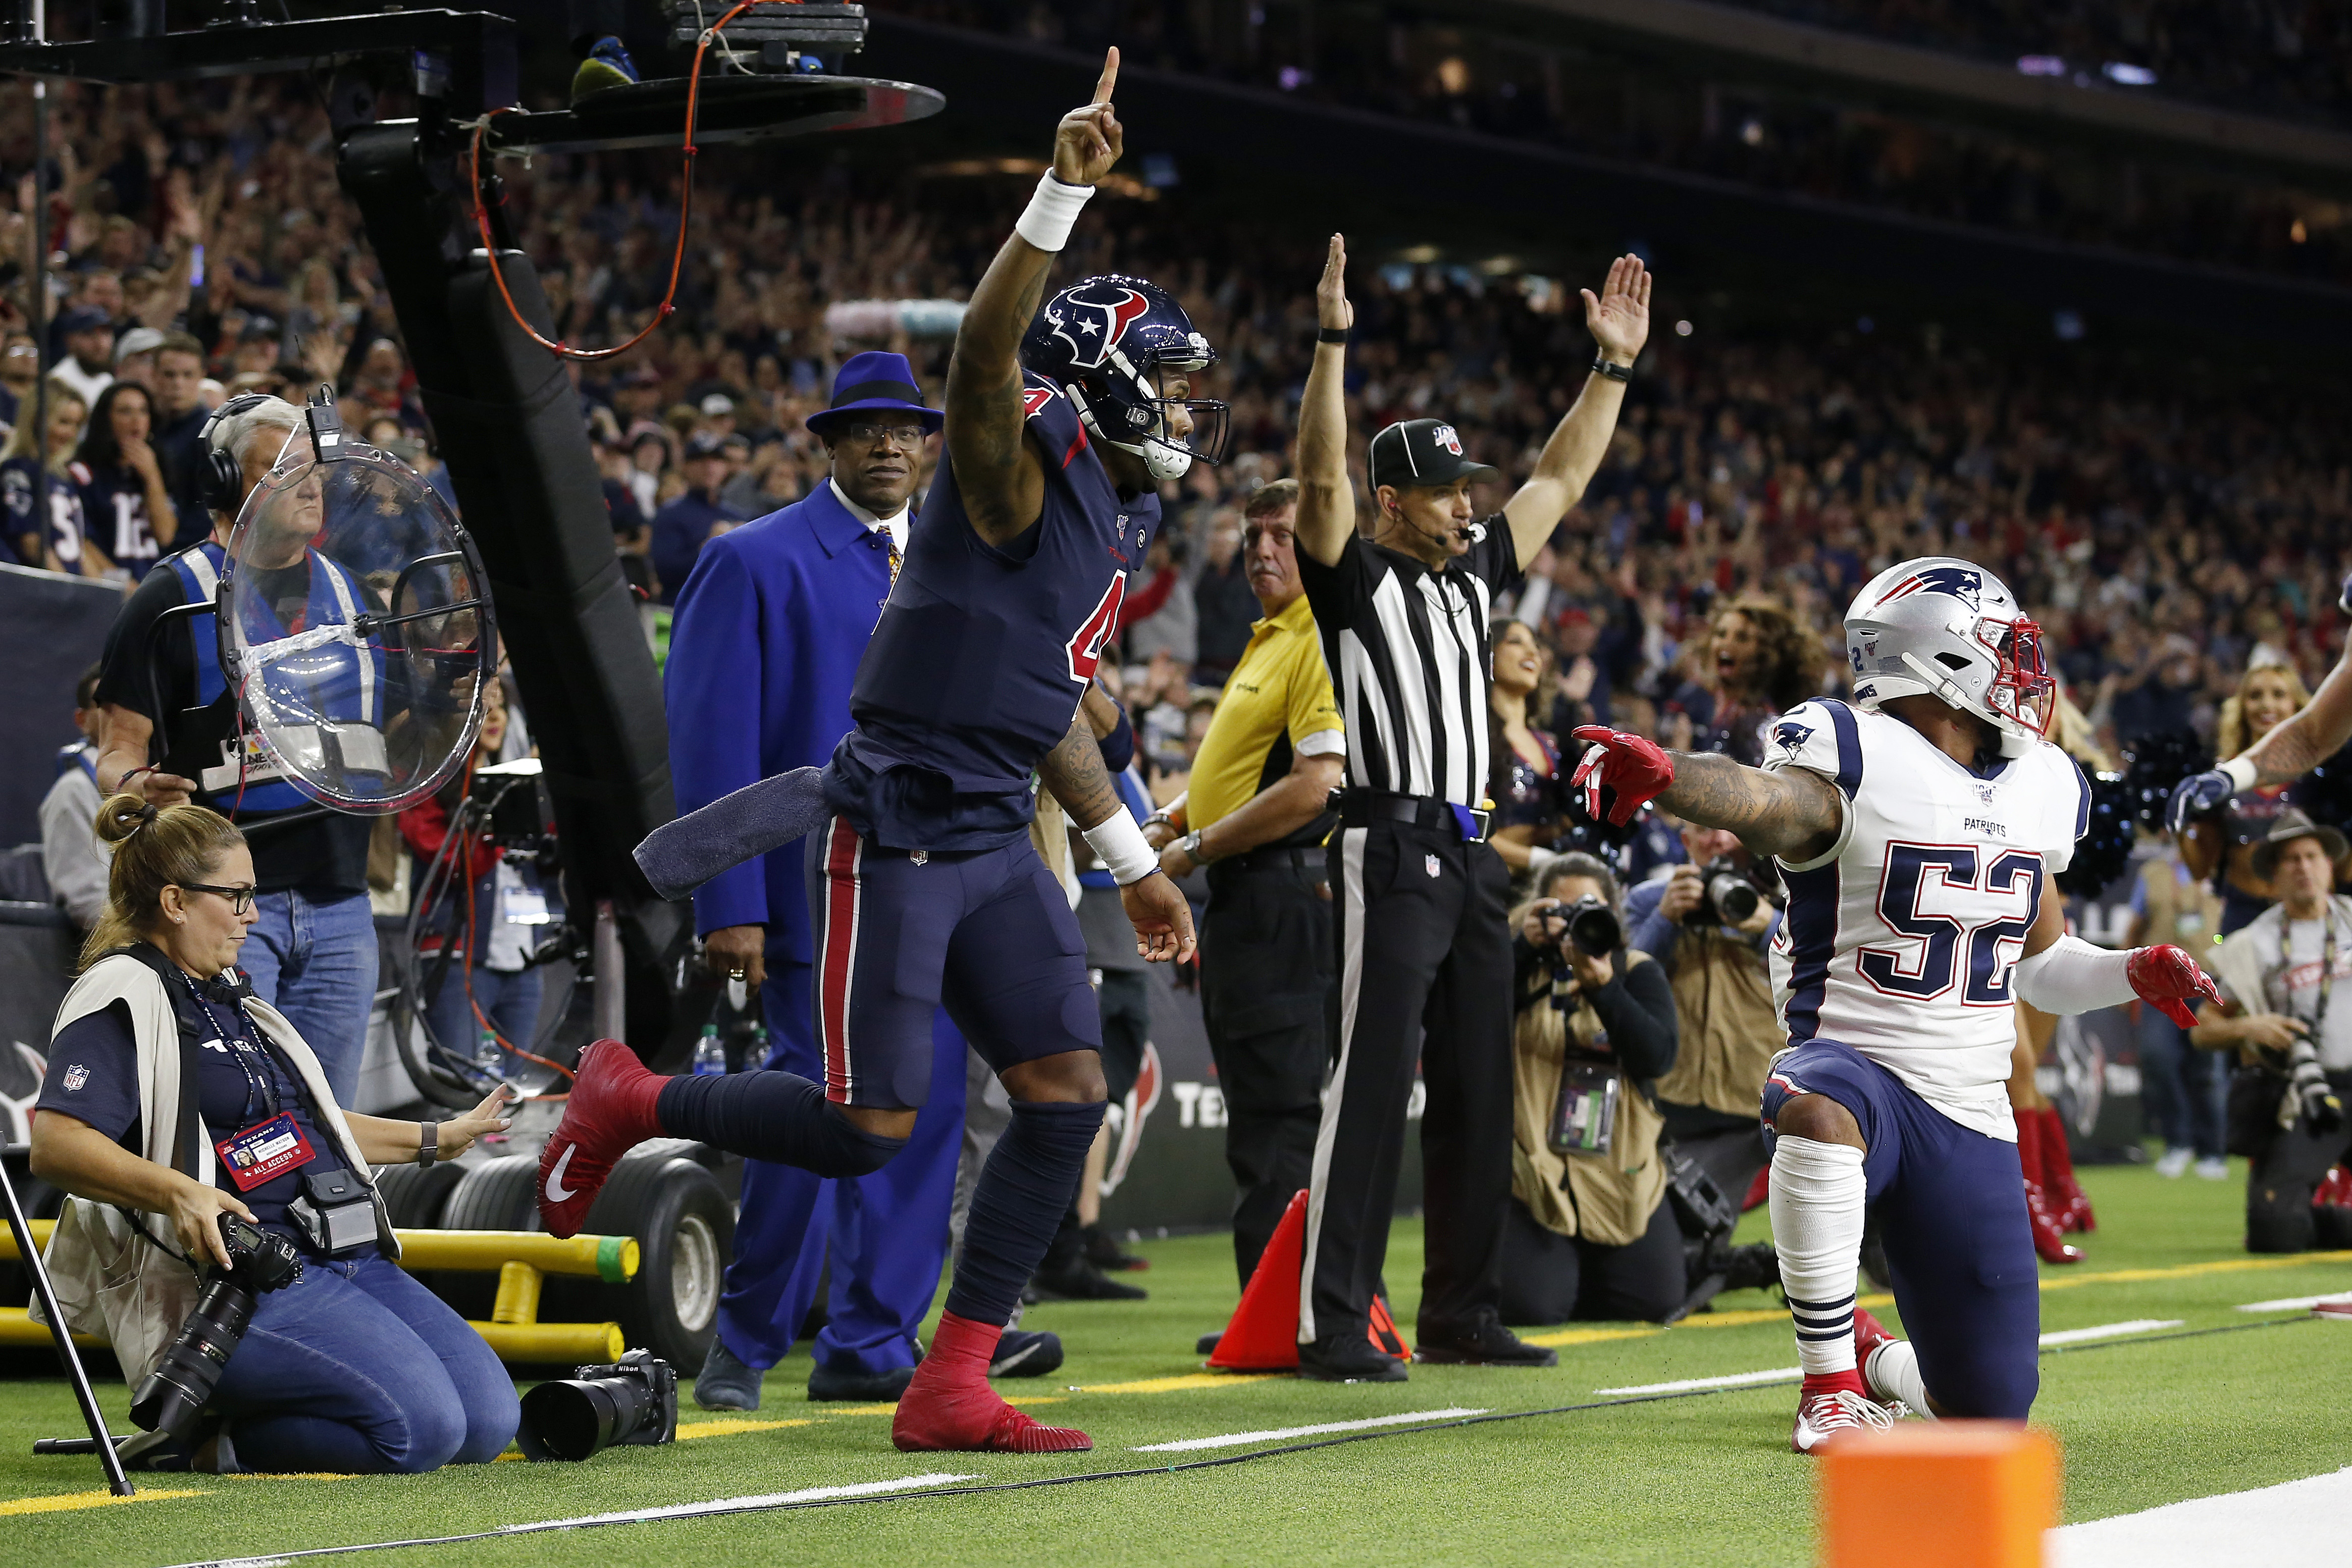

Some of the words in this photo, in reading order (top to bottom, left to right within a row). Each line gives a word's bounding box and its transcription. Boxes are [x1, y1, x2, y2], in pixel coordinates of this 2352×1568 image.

[1065, 569, 1127, 722] 4
[1964, 817, 2006, 837] PATRIOTS
[1856, 840, 2045, 1007] 52
[204, 1007, 225, 1037] TEXANS
[66, 1074, 81, 1087] NFL
[235, 1053, 254, 1084] TEXANS
[1172, 1081, 1229, 1128] TE
[239, 1127, 275, 1145] TEXANS
[254, 1165, 267, 1175] ALL
[268, 1152, 293, 1168] ACCESS
